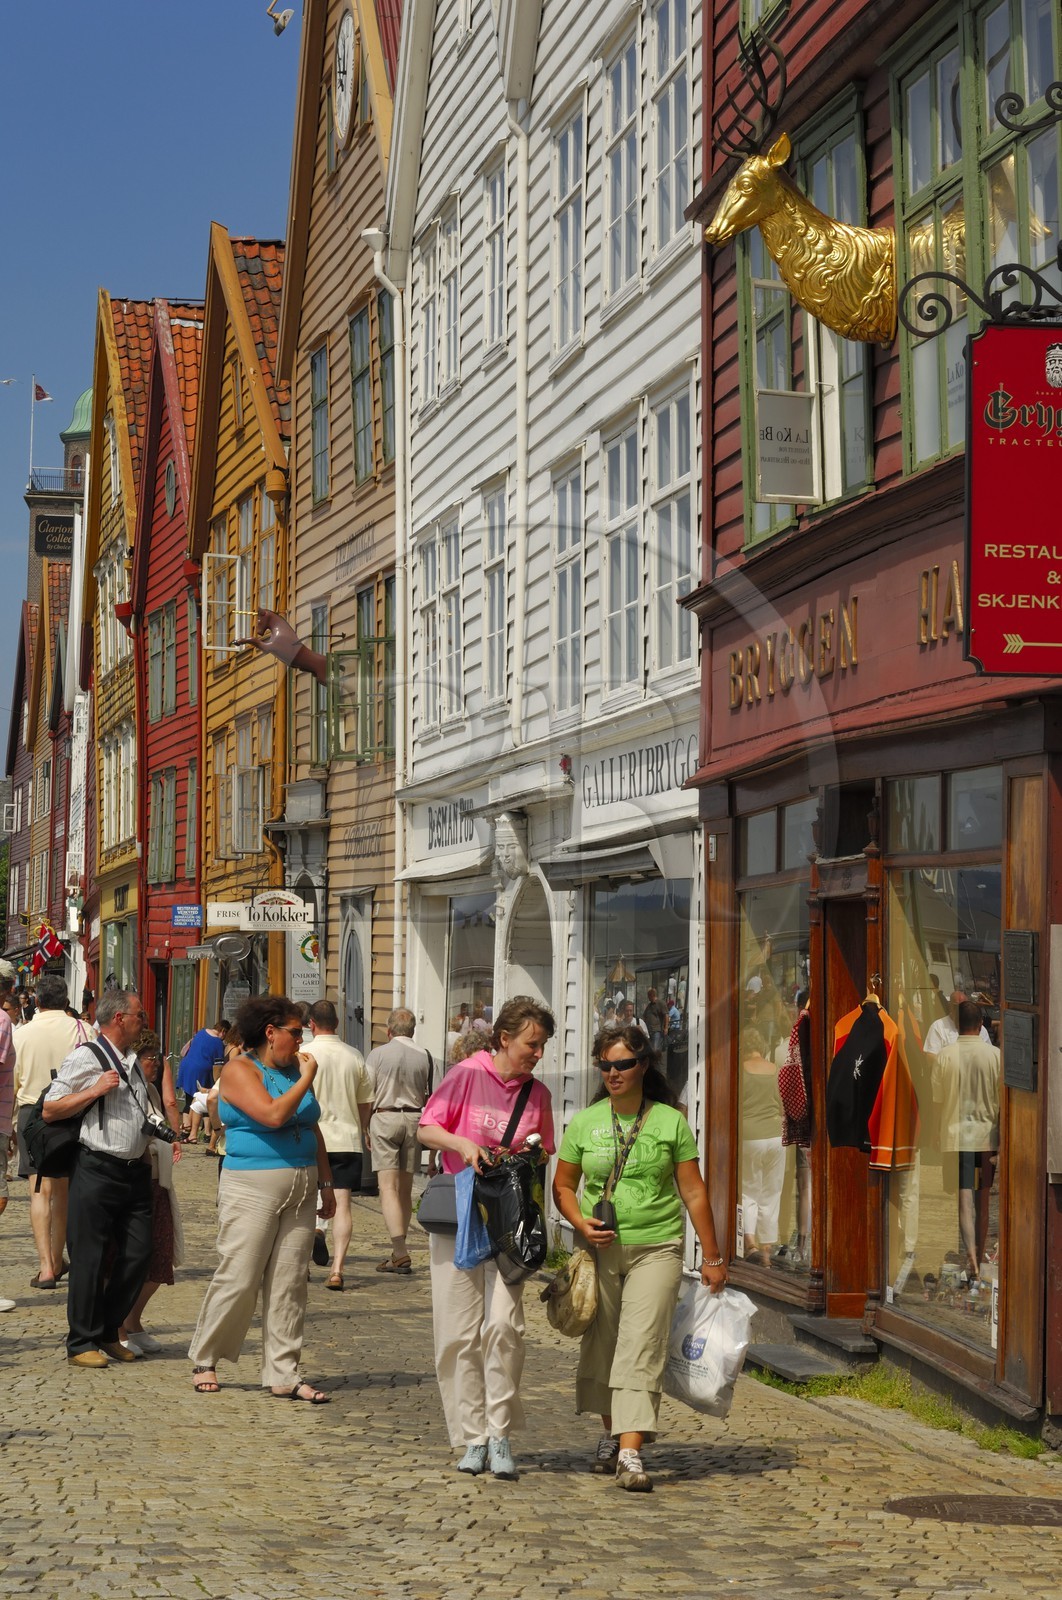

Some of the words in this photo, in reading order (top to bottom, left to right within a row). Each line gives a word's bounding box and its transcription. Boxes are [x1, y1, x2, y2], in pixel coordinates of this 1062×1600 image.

[988, 438, 1062, 446] TRACTE
[1046, 570, 1062, 584] &
[729, 596, 858, 710] BRYGGEN
[244, 906, 260, 922] To
[262, 906, 309, 922] Kokker
